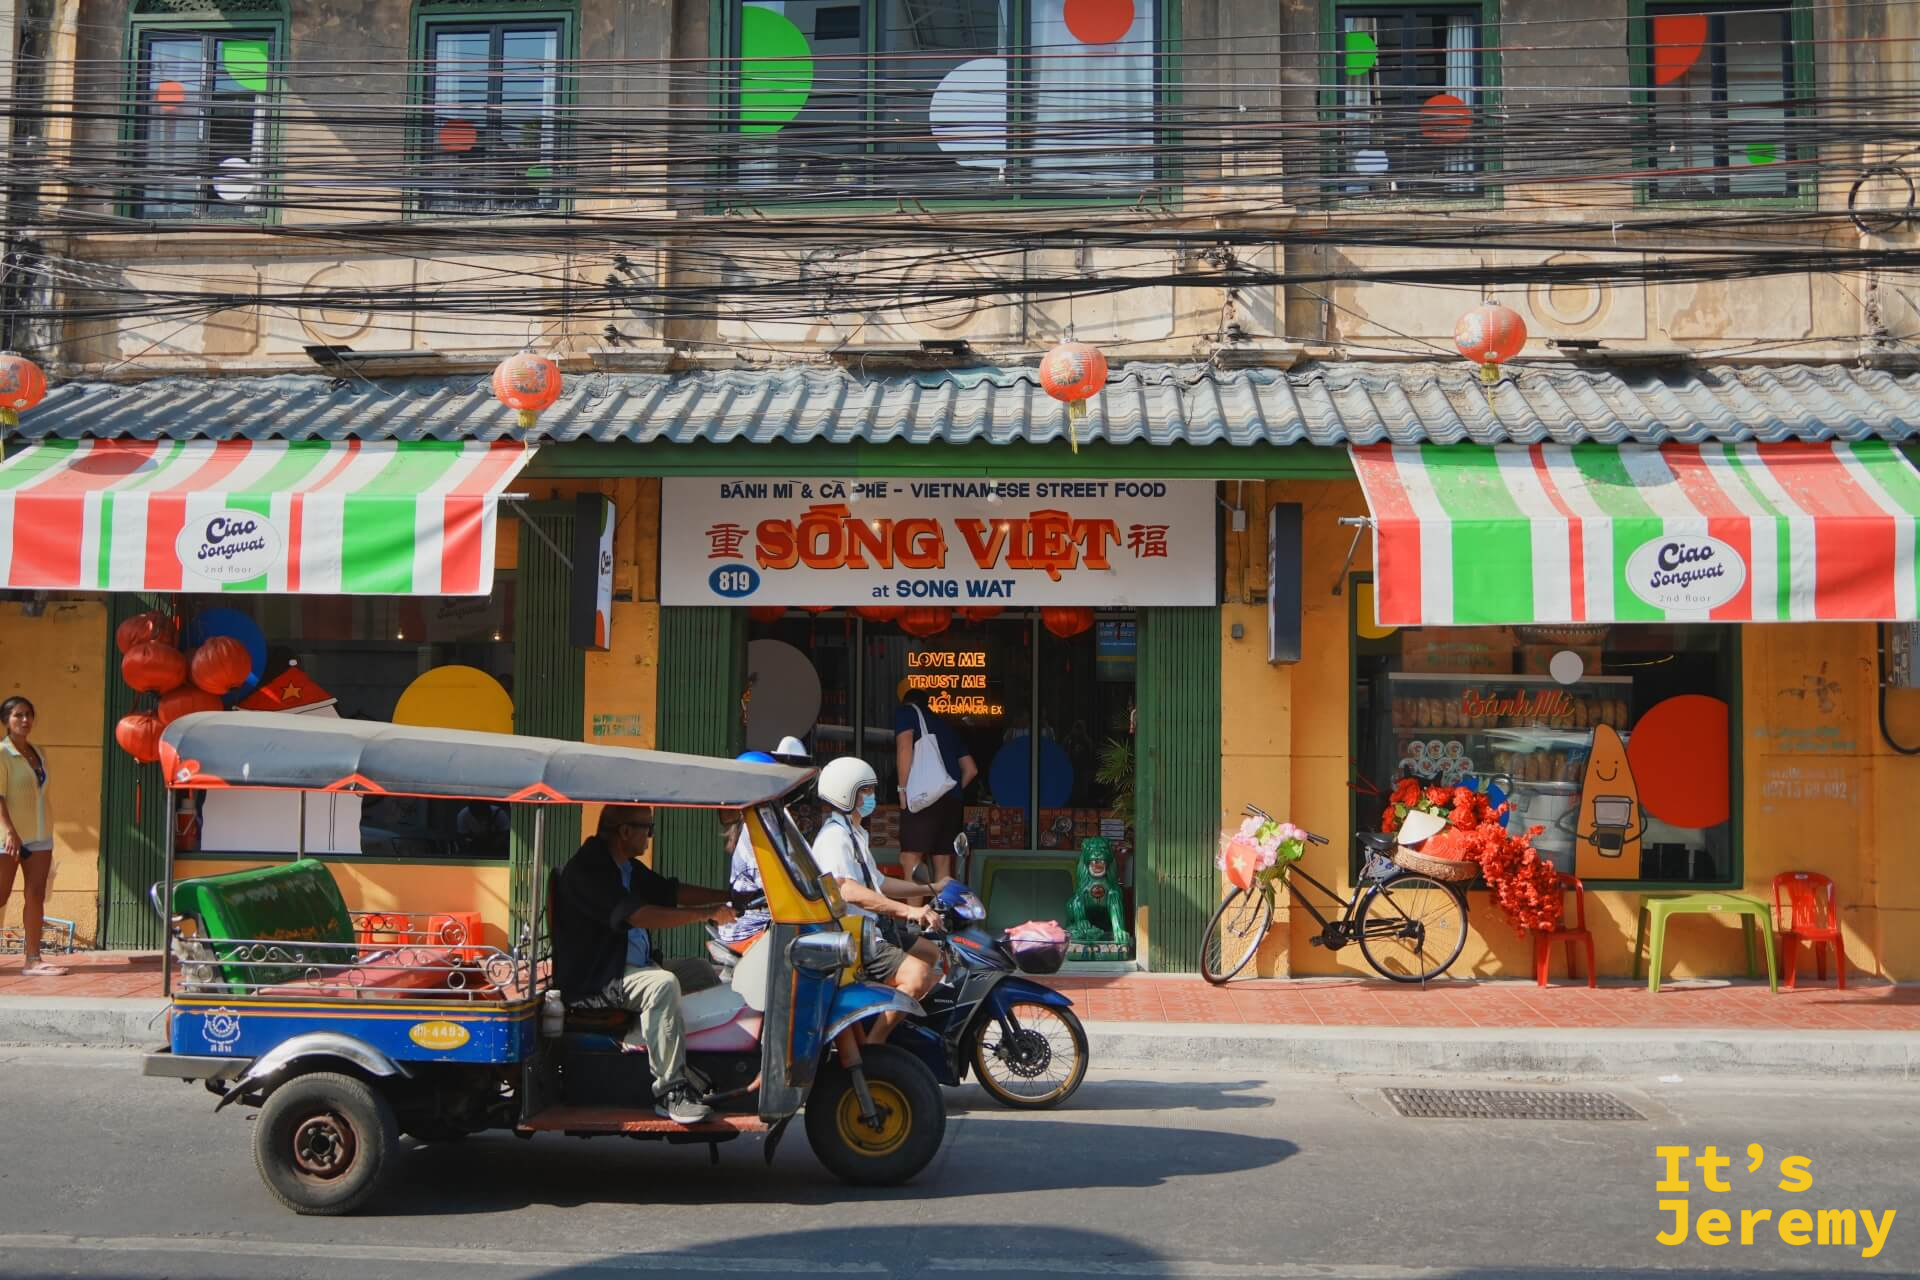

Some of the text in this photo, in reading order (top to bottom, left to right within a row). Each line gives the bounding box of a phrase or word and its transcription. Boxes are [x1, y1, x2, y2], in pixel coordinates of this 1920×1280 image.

[720, 480, 767, 498] BÁNH
[801, 483, 813, 498] &
[911, 482, 1030, 498] VIETNAMESE
[1036, 482, 1108, 498] STREET
[1114, 482, 1166, 498] FOOD
[206, 517, 257, 544] Ciao
[705, 523, 749, 559] 重
[1128, 523, 1170, 558] 福
[198, 536, 265, 560] Songwat
[954, 509, 1122, 582] VIỆT
[1658, 543, 1715, 572] Ciao
[204, 565, 252, 574] 2nd floor
[1650, 562, 1725, 588] Songwat
[719, 571, 750, 591] 819
[872, 580, 1015, 598] at SONG WAT
[1660, 593, 1711, 603] 2nd floor
[908, 652, 986, 667] LOVE ME
[908, 674, 986, 689] TRUST ME
